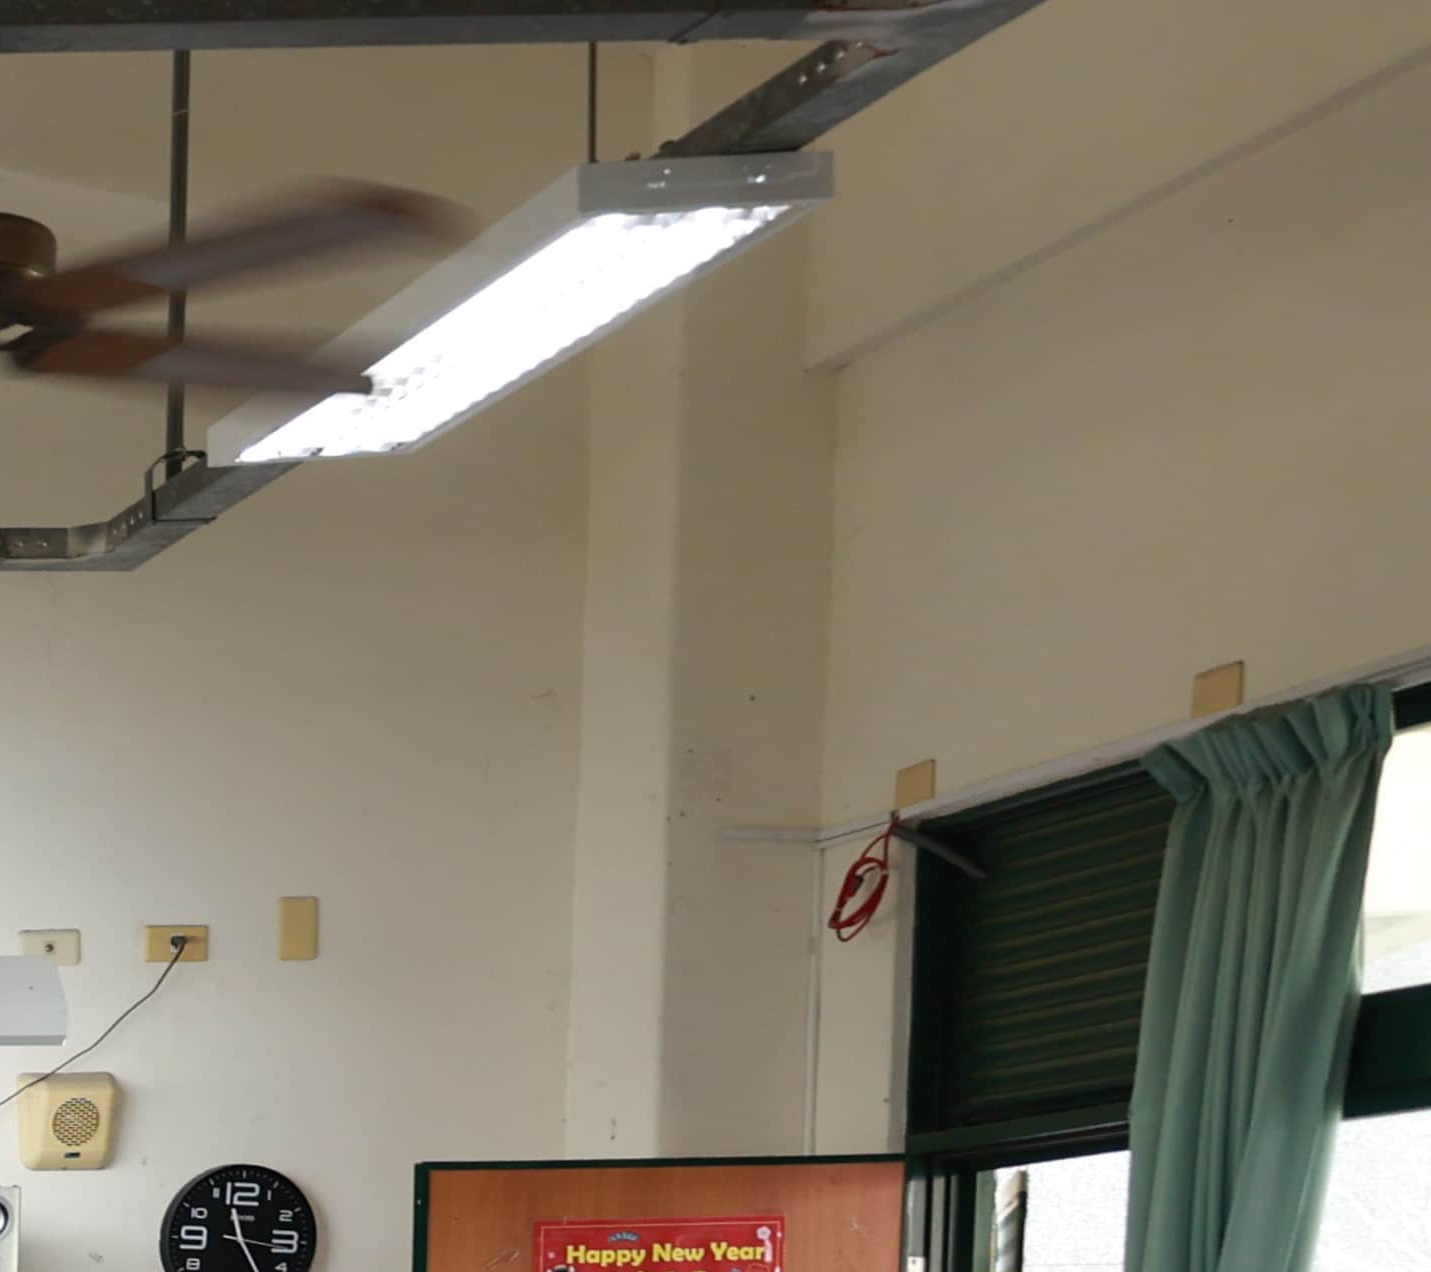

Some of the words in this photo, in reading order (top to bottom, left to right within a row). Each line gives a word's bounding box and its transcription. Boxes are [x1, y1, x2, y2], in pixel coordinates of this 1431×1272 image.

[225, 1181, 261, 1207] 12
[190, 1207, 208, 1219] 10
[278, 1209, 294, 1222] 2
[179, 1225, 208, 1251] 9
[270, 1229, 300, 1254] 3
[185, 1257, 201, 1271] 8
[566, 1244, 646, 1268] Happy
[653, 1242, 704, 1263] New
[710, 1241, 767, 1262] Year
